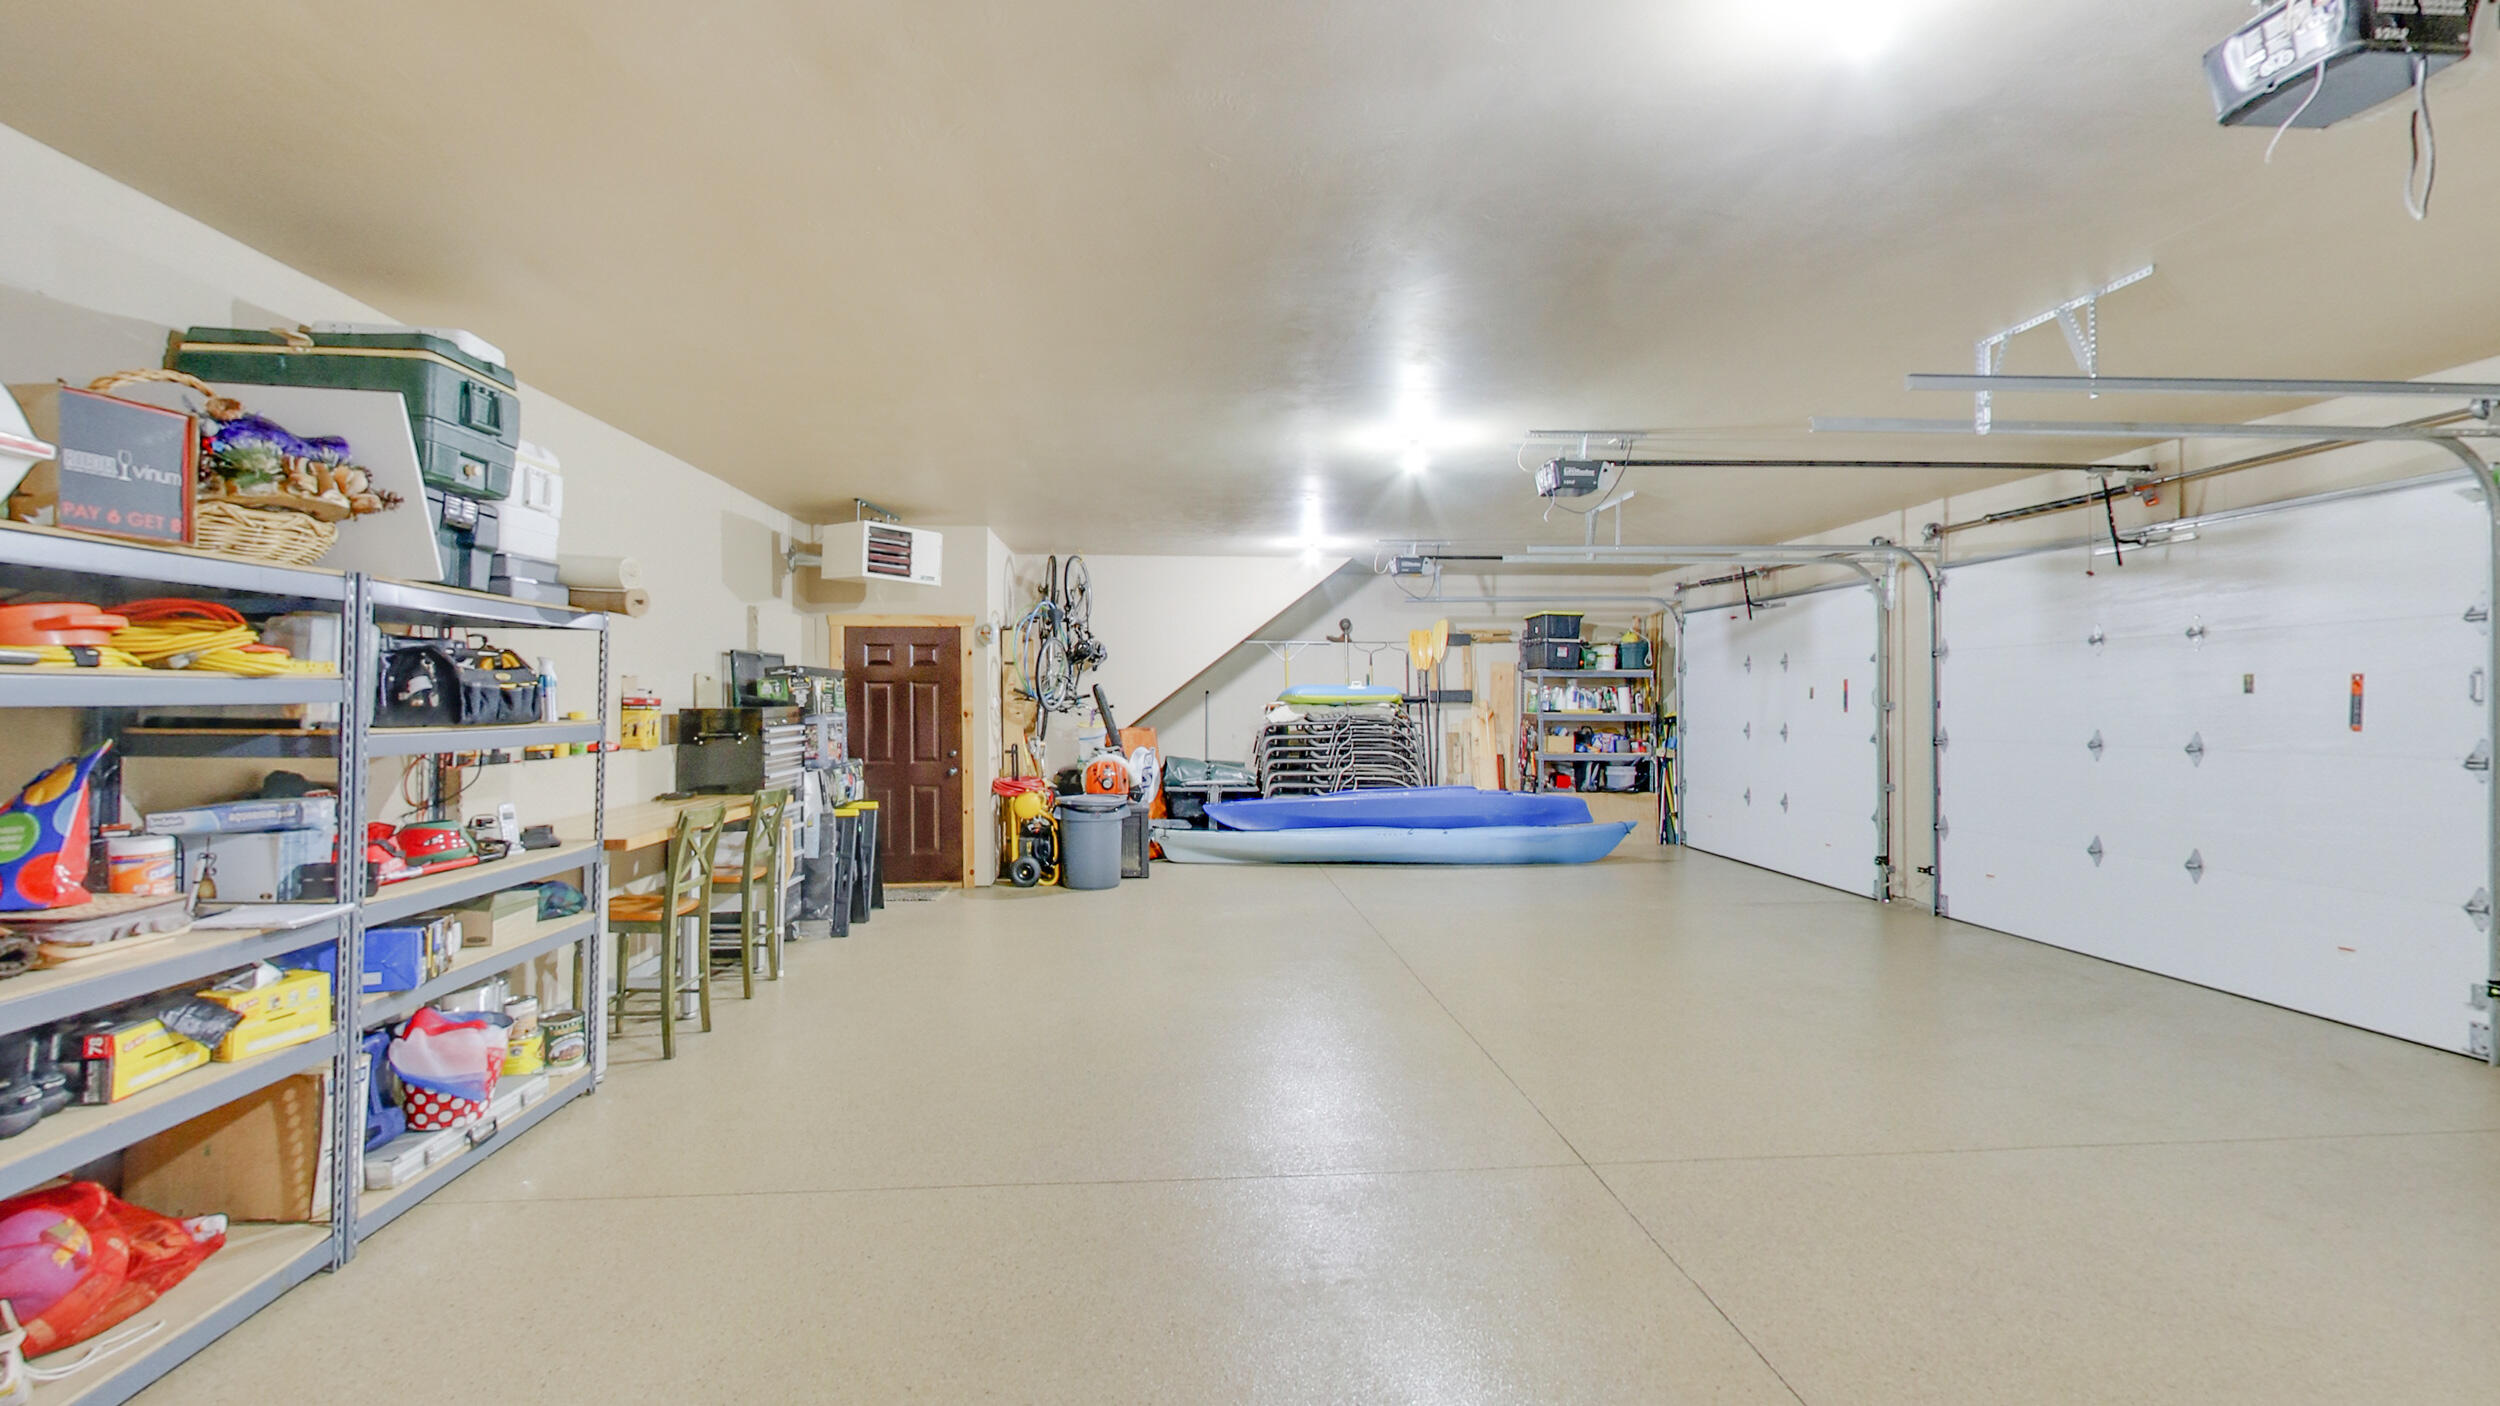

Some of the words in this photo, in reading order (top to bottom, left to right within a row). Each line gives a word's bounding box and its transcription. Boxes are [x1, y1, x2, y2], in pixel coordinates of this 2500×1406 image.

[132, 464, 182, 487] vinum
[61, 500, 101, 520] PAY
[106, 508, 121, 525] 6
[127, 511, 165, 531] GET
[87, 1036, 104, 1057] 78
